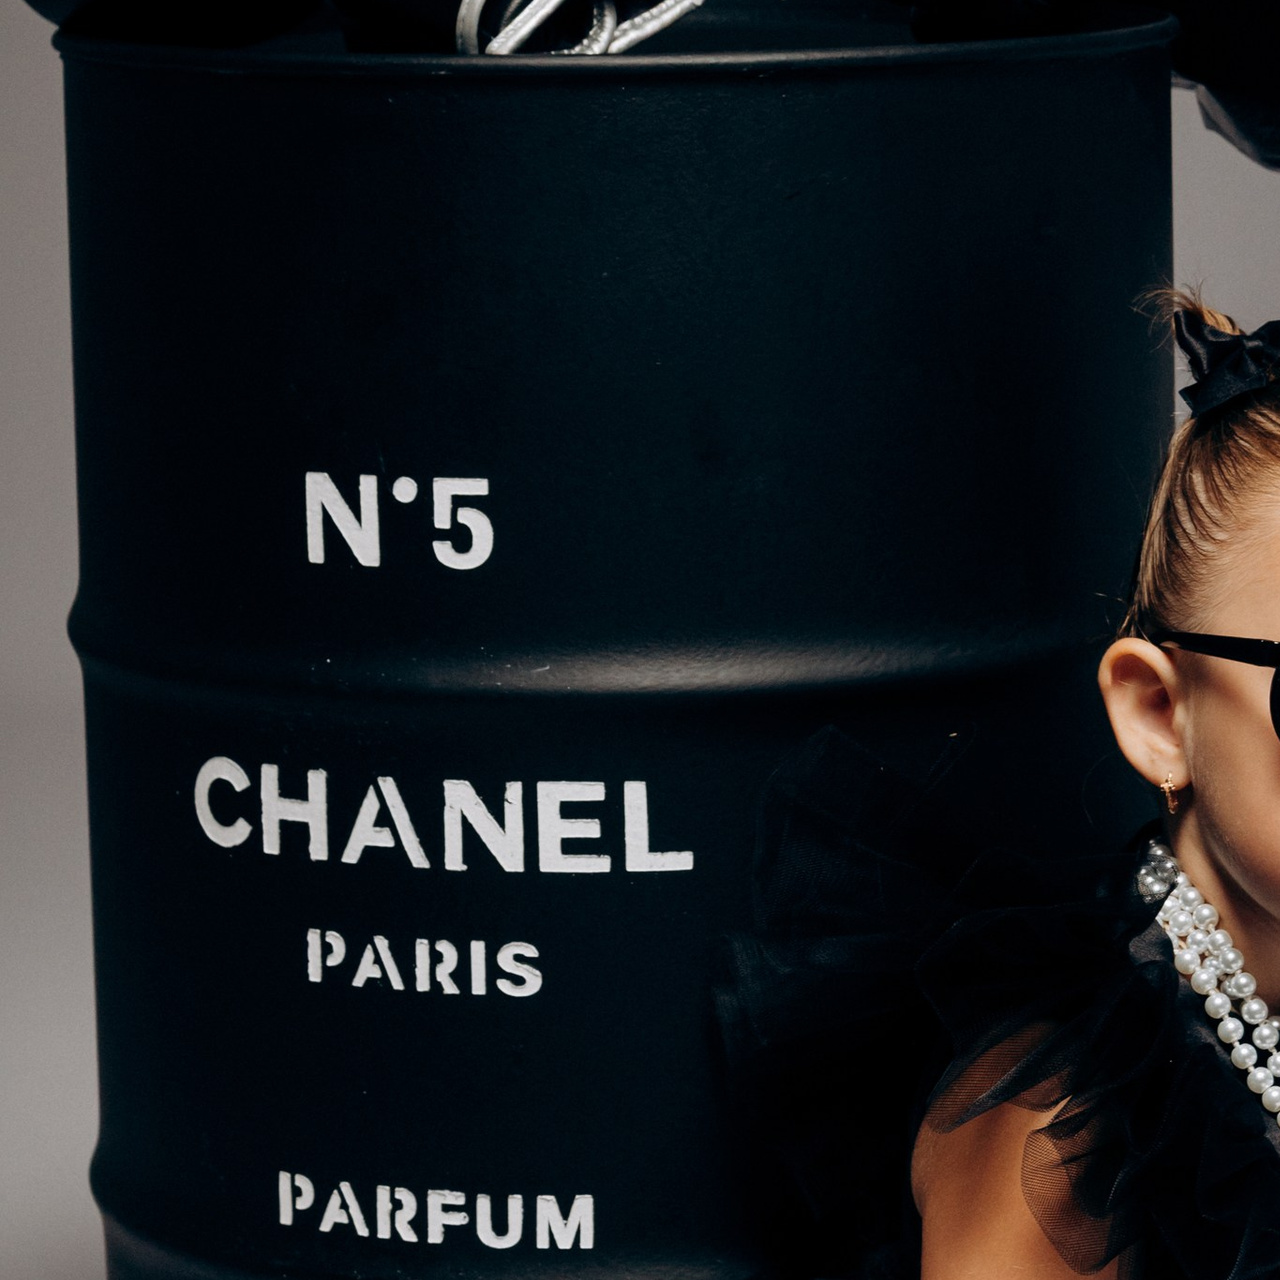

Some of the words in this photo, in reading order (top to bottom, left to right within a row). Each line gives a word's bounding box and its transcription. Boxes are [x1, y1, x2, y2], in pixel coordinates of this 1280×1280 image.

[194, 755, 695, 874] CHANEL
[306, 928, 544, 998] PARIS
[278, 1170, 596, 1250] PARFUM
